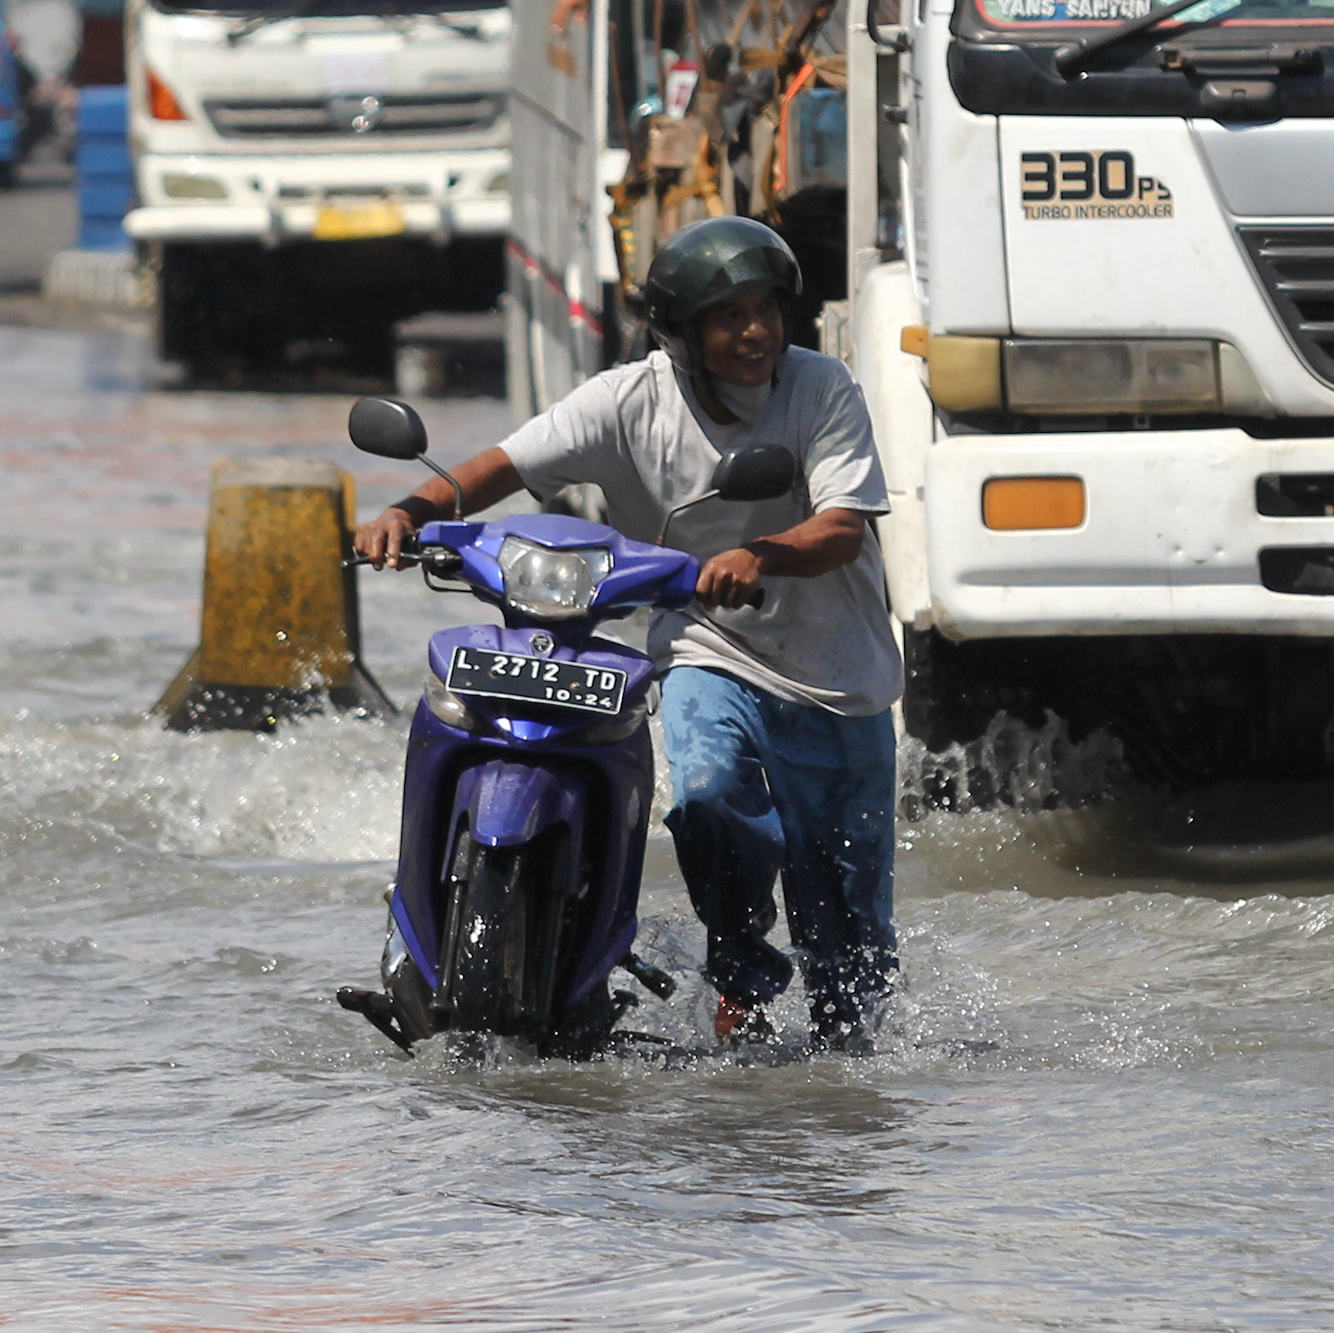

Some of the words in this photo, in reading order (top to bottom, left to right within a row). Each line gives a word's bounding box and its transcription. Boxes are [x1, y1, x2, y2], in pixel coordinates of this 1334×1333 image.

[1023, 205, 1071, 219] TURBO
[1075, 204, 1172, 219] INTERCOOLER
[491, 655, 559, 683] 2712
[584, 669, 616, 691] TD
